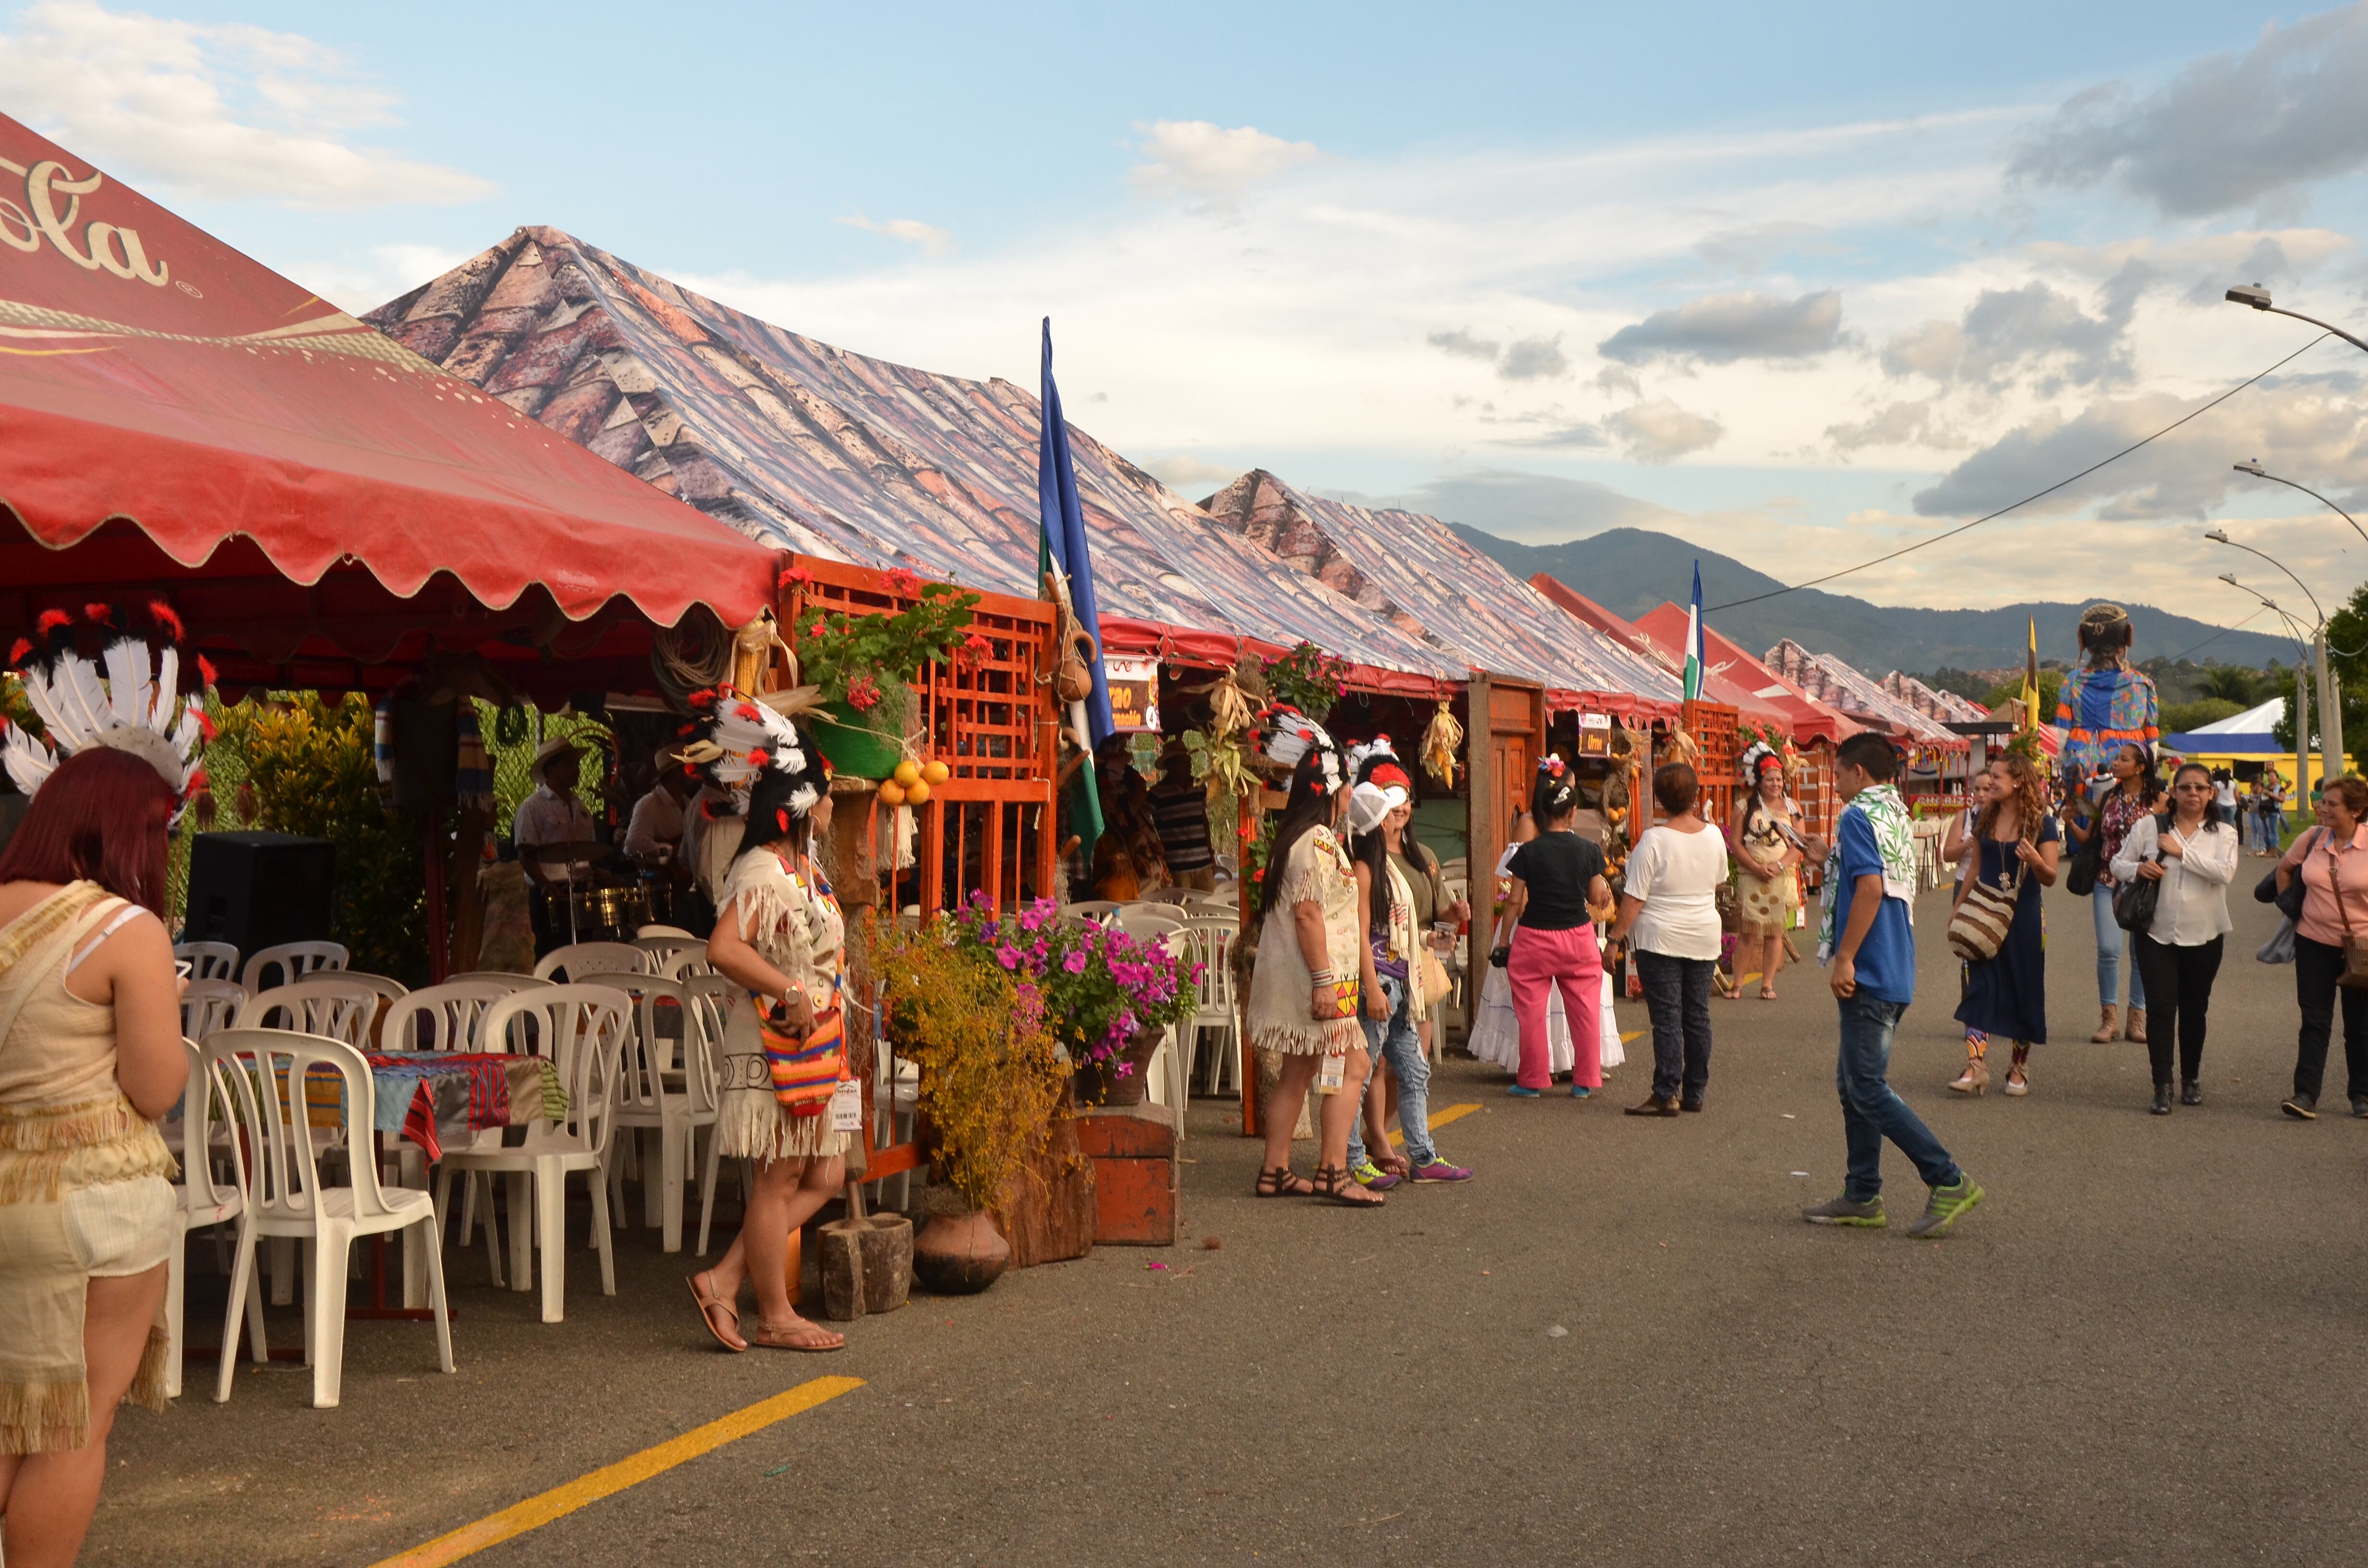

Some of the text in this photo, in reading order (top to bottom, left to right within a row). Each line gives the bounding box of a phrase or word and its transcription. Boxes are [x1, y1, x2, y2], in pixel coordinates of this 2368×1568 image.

[0, 157, 169, 287] ola
[1109, 686, 1132, 709] rao
[1917, 796, 1973, 806] CHORIZO
